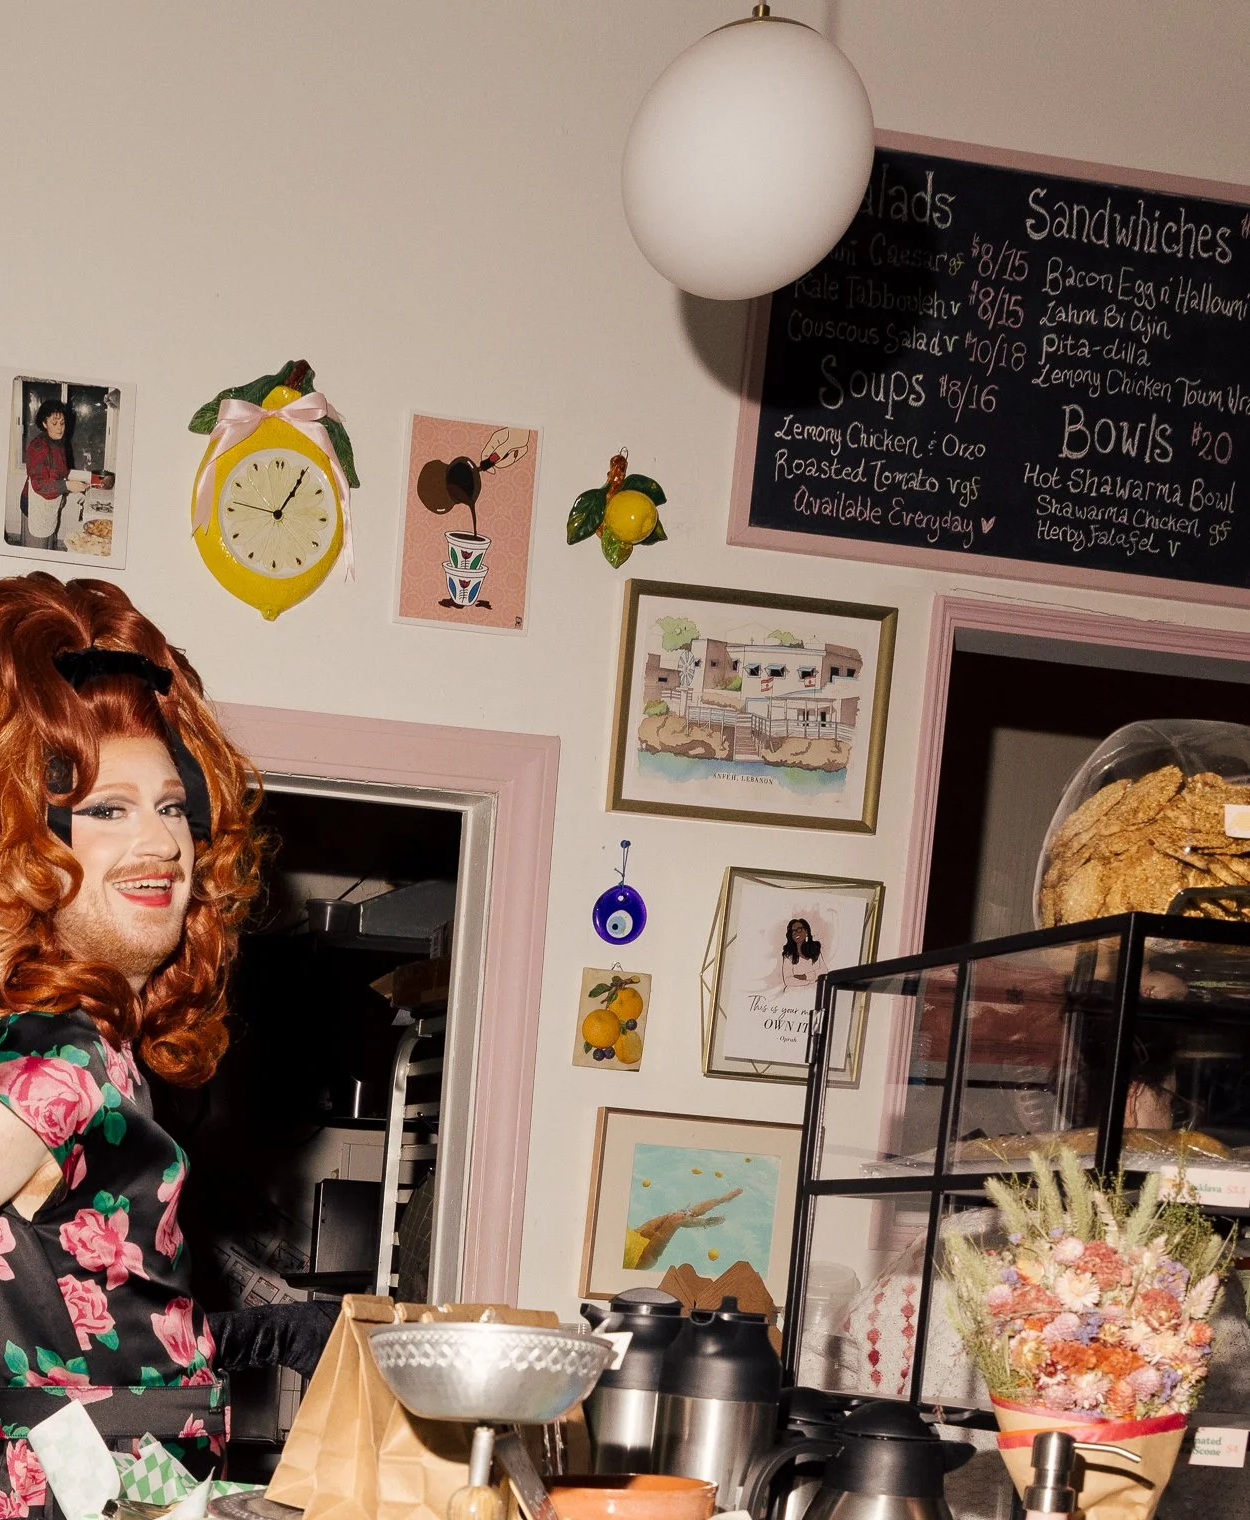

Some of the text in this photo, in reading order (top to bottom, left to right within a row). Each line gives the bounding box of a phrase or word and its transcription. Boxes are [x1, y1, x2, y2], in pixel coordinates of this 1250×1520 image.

[860, 162, 957, 230] lads
[1025, 187, 1233, 264] Sandwhiches
[868, 231, 948, 272] Caesar
[971, 232, 1029, 281] $8/15
[794, 271, 840, 301] Kale
[845, 275, 948, 320] Tabbouleh
[968, 280, 1025, 330] $8/15
[1042, 256, 1113, 295] Bacon
[1118, 266, 1156, 310] Egg
[1175, 276, 1250, 321] Halloumi
[1040, 301, 1098, 326] Lahm
[1104, 304, 1125, 329] Bi
[787, 309, 880, 345] Couscous
[883, 322, 943, 356] Salad
[965, 329, 1027, 376] $10/18
[1038, 334, 1151, 367] Pita-dilla
[818, 353, 999, 423] Soups $8/16
[1032, 364, 1100, 398] Lemony
[1107, 369, 1172, 403] Chicken
[1175, 377, 1225, 412] Toum
[775, 414, 842, 456] Lemony
[846, 421, 923, 459] Chicken
[942, 433, 986, 460] Orzo
[1058, 403, 1233, 464] Bowls $20
[774, 448, 867, 483] Roasted
[870, 459, 939, 492] Tomato
[1024, 463, 1236, 513] Hot Shawarma Bowl
[793, 485, 974, 549] Available Everyday
[1036, 495, 1232, 546] Shawarma Chicken gf
[1037, 520, 1085, 552] Herby
[1088, 525, 1160, 556] Falafel
[741, 775, 774, 785] LEBANON
[748, 994, 767, 1012] This
[770, 1005, 778, 1014] is
[764, 1018, 792, 1032] OWN
